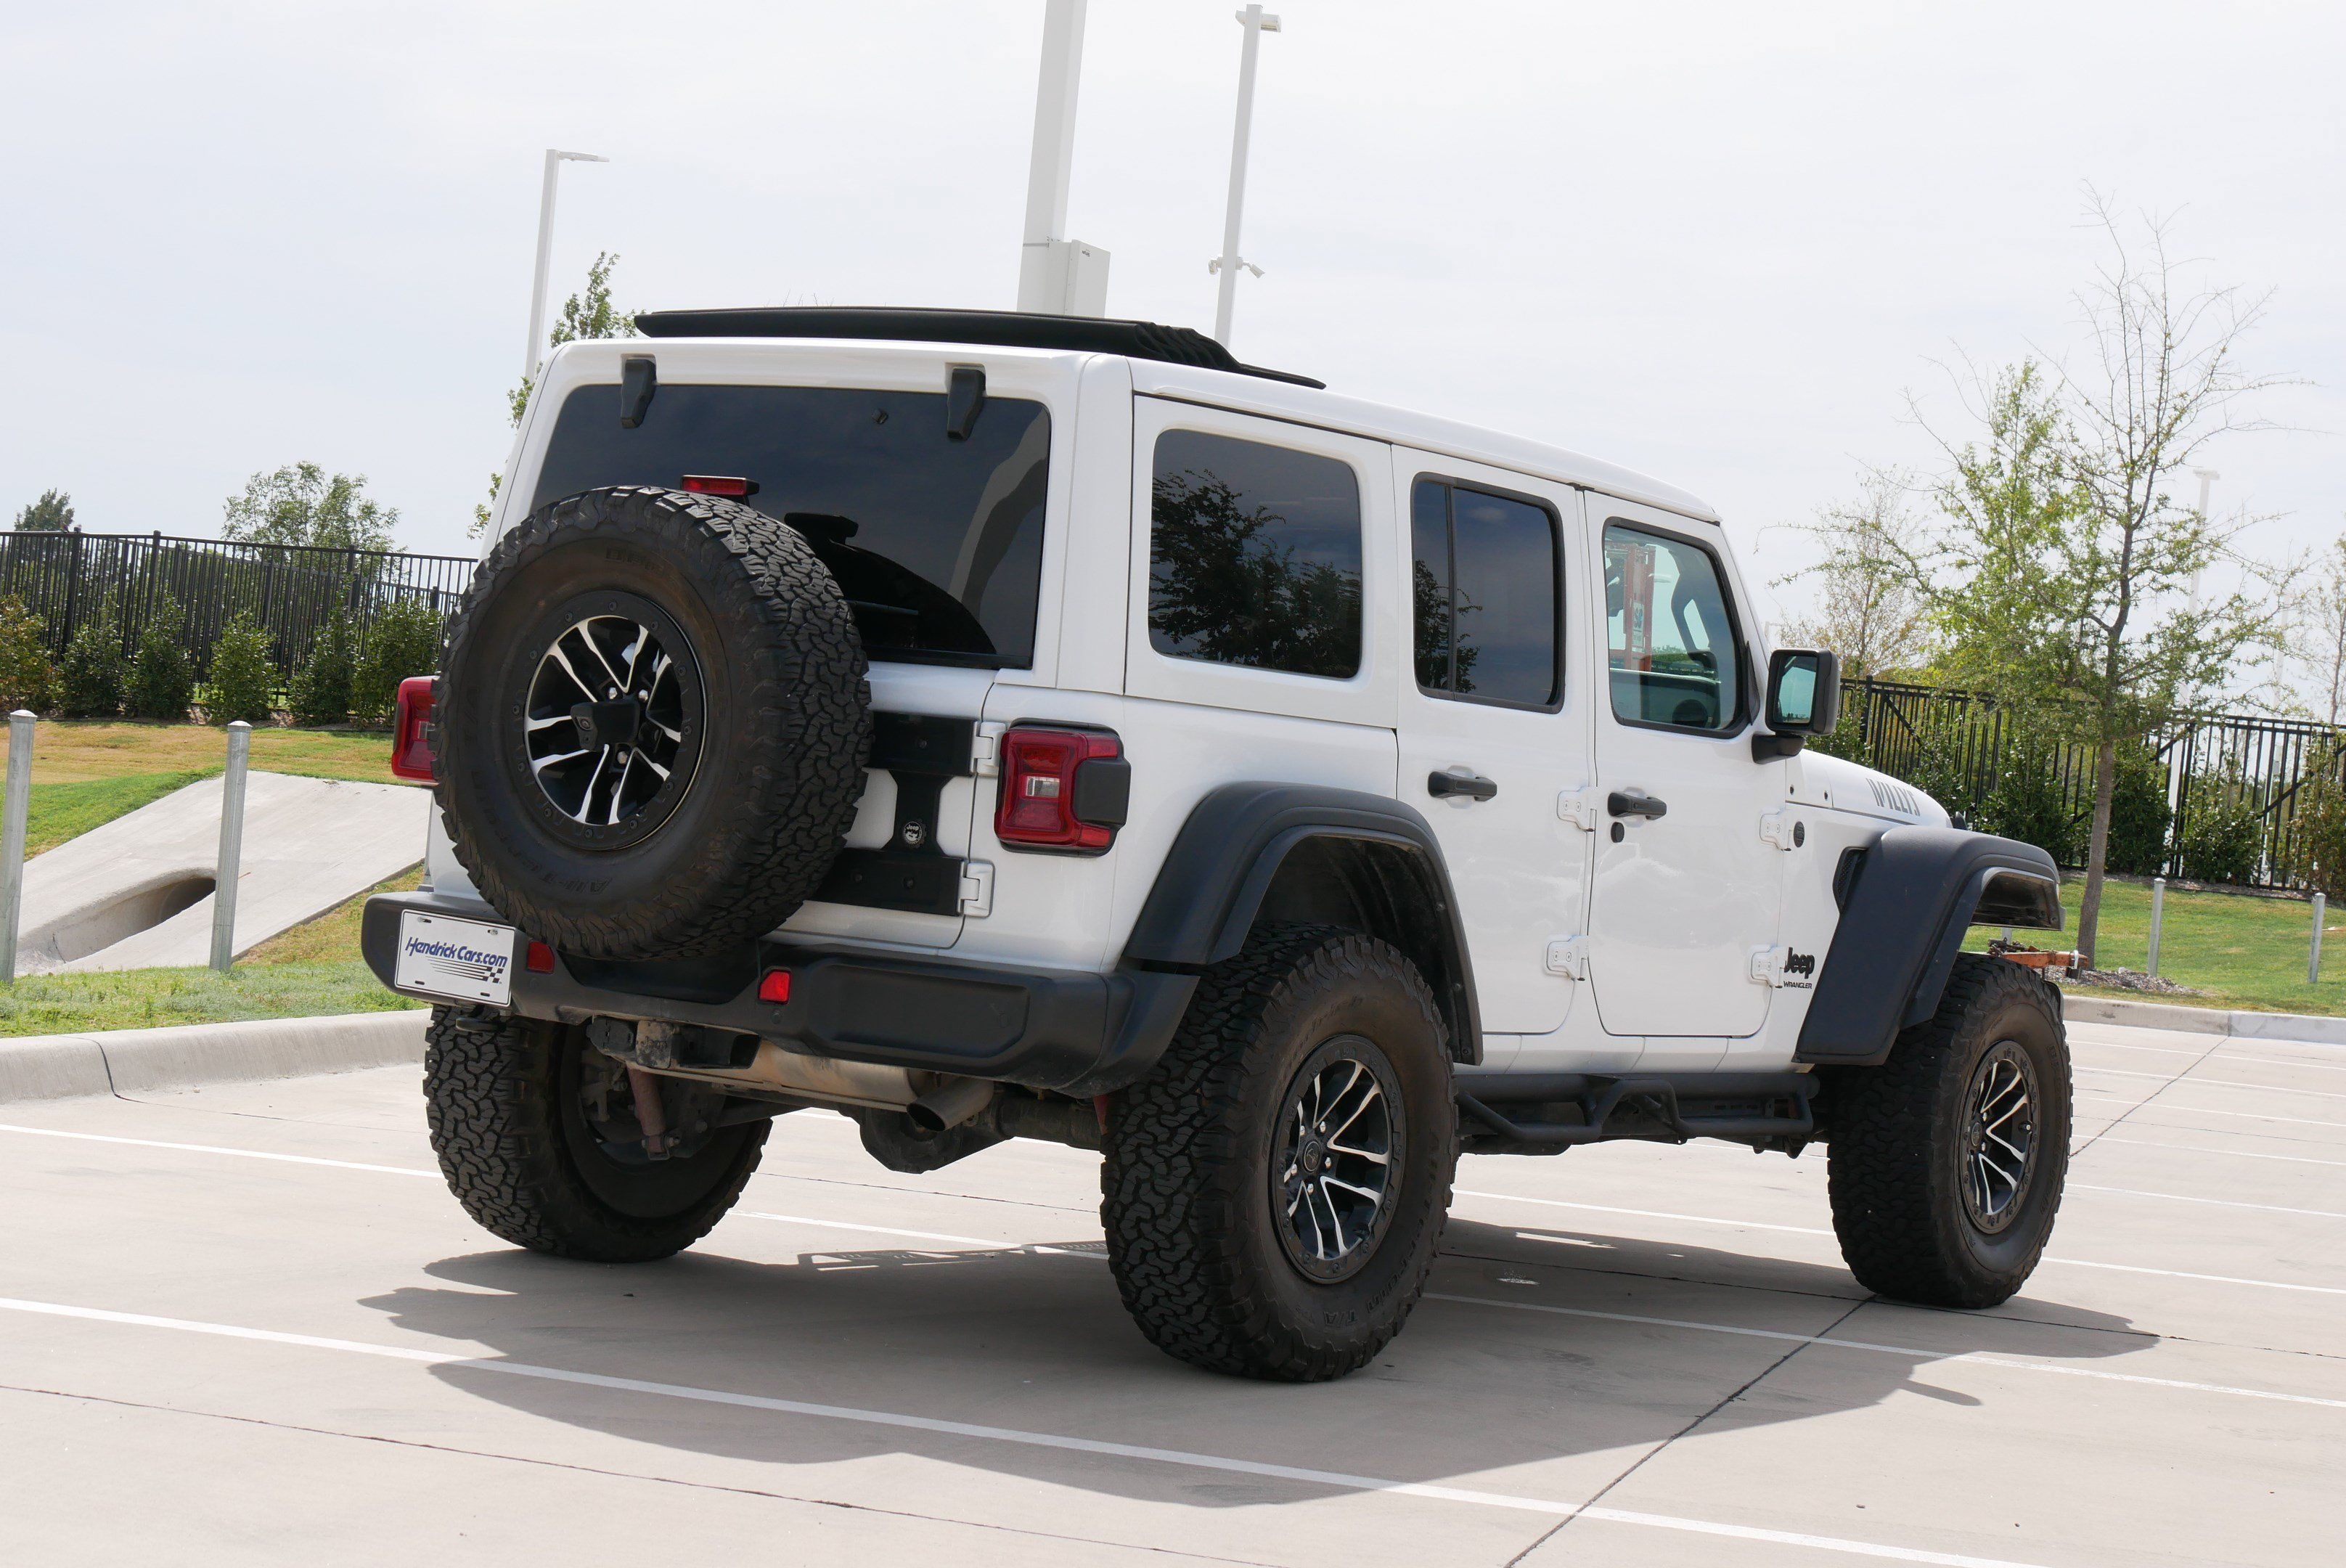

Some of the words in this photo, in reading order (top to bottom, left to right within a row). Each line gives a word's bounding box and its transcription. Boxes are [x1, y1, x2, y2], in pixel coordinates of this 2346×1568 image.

[1866, 778, 1921, 817] WILLYS
[1784, 947, 1815, 979] Jeep
[1783, 981, 1812, 989] WRANGLER
